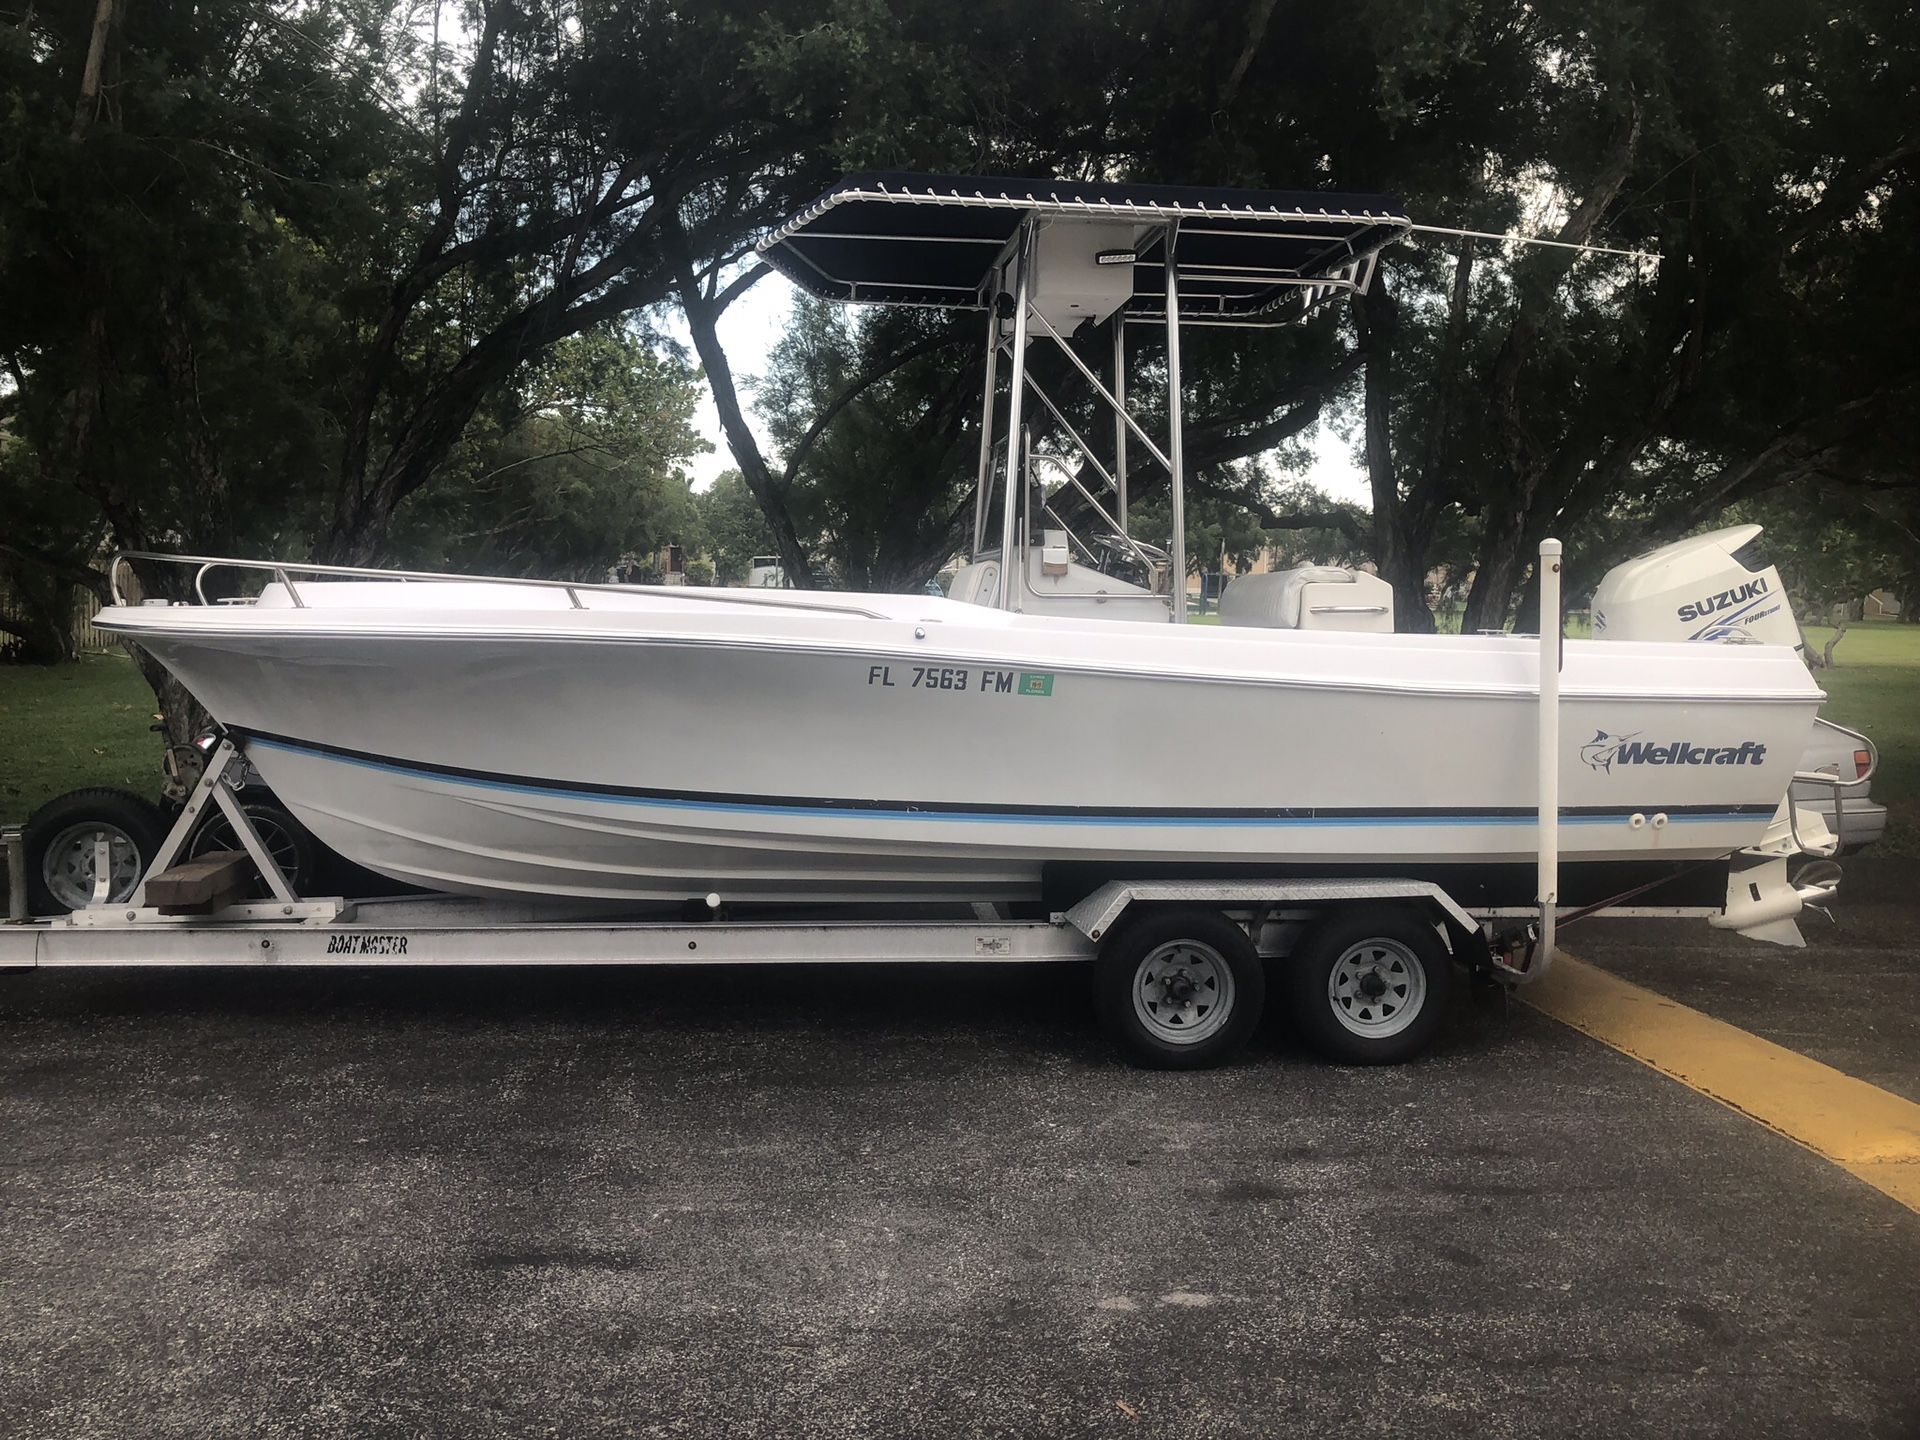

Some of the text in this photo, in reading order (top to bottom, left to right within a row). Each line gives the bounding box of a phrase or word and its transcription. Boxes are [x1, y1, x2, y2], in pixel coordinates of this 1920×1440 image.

[1677, 577, 1768, 622] SUZUKI
[868, 666, 895, 687] FL
[911, 667, 968, 691] 7563
[980, 671, 1014, 693] FM
[1617, 741, 1767, 766] Wellcraft
